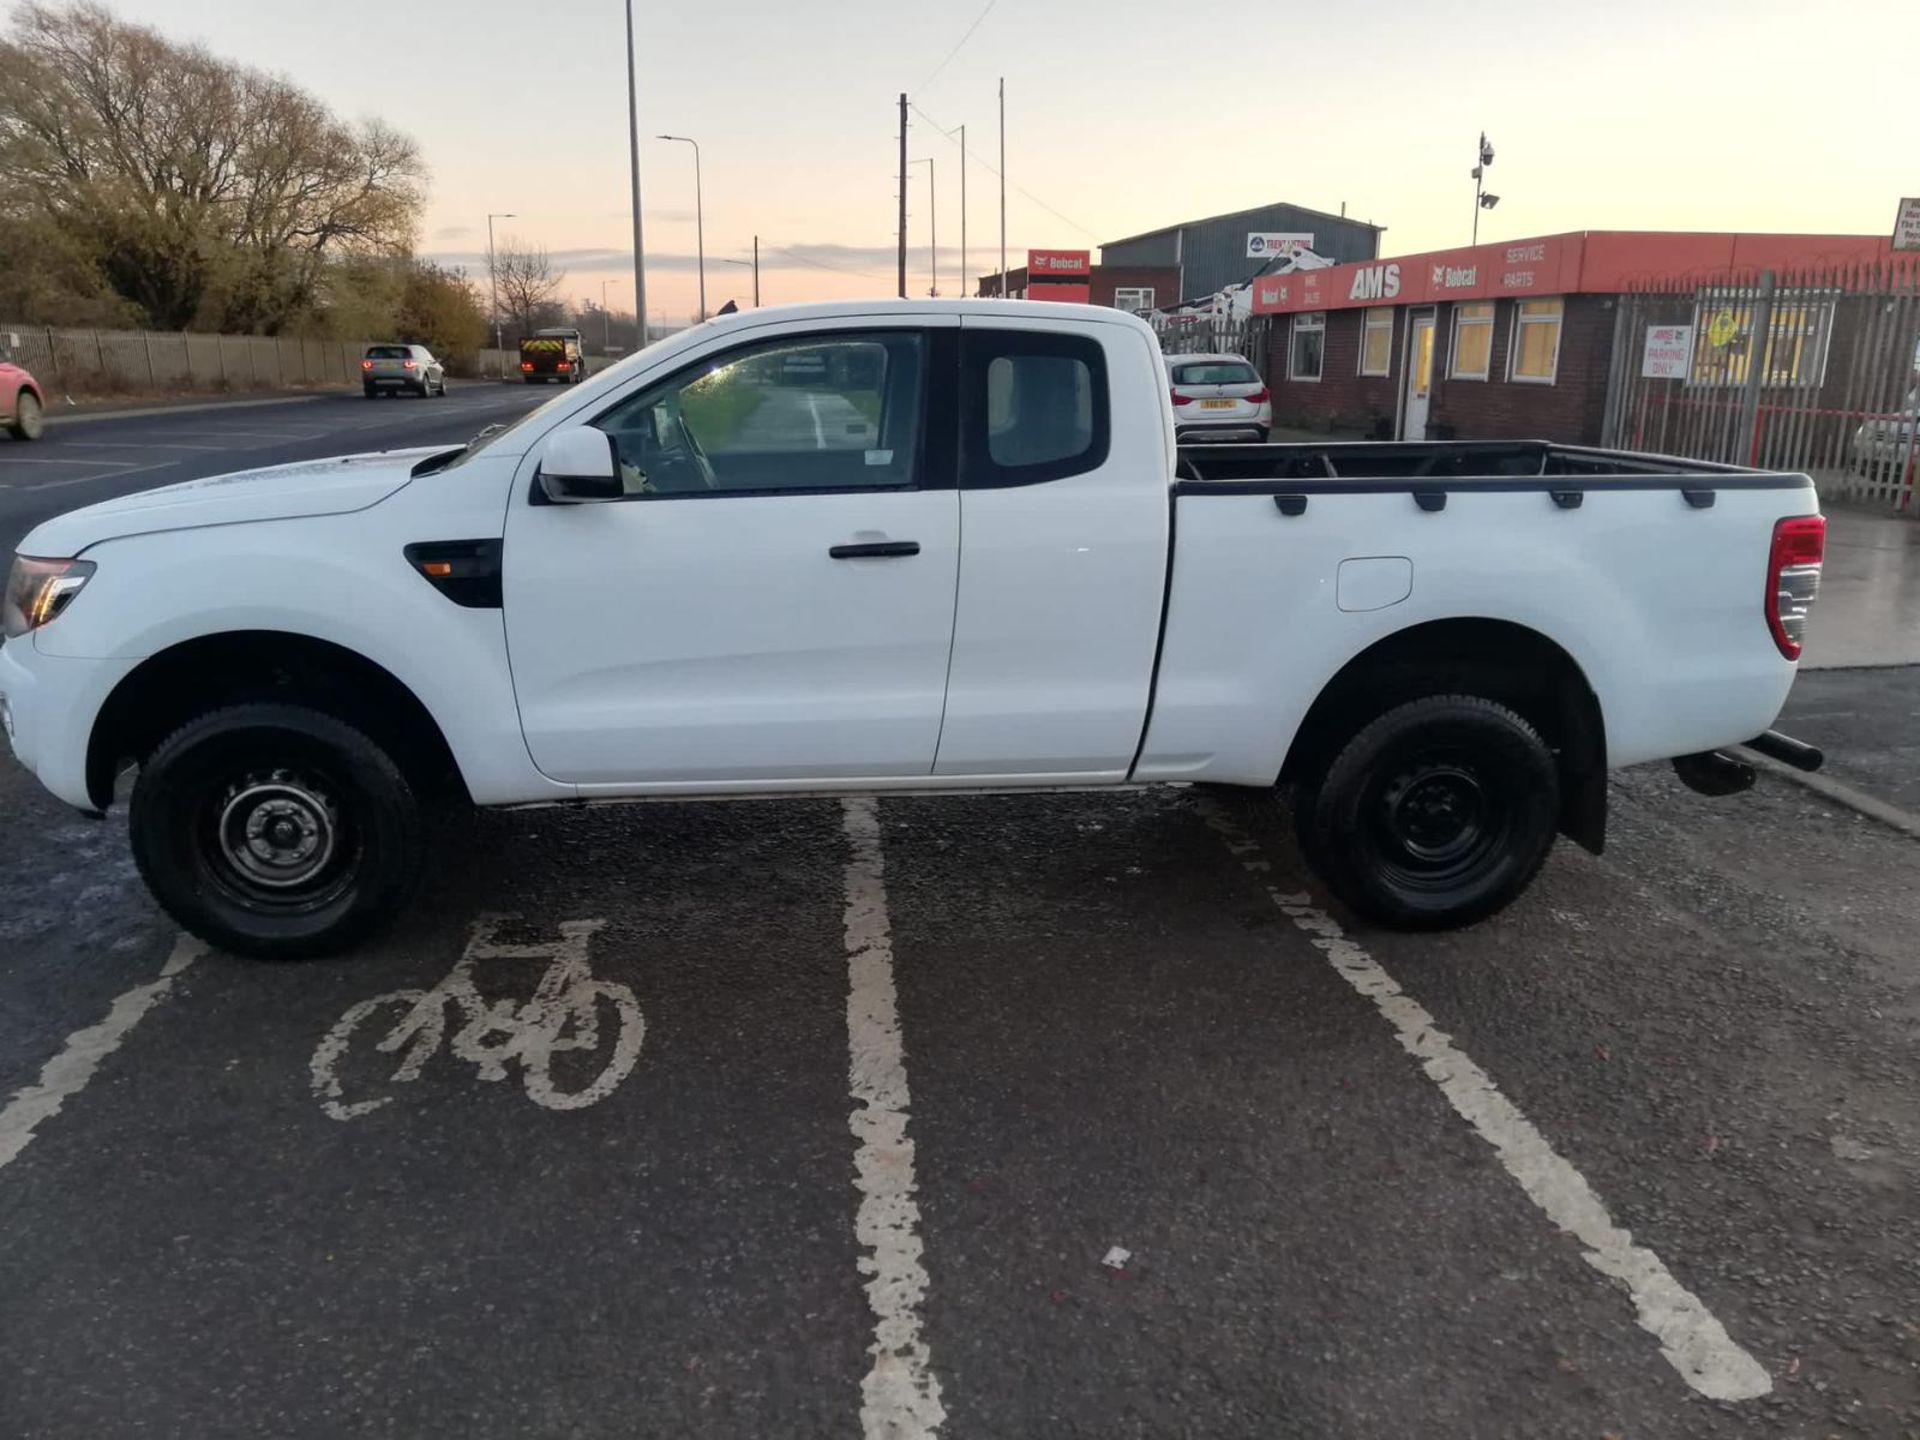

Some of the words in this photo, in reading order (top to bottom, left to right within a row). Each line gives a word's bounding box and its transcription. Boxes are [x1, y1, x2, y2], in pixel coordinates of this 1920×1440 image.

[1267, 240, 1286, 250] TRENT
[1507, 244, 1545, 263] SERVICE
[1050, 256, 1083, 269] Bobcat
[1349, 263, 1401, 300] AMS
[1445, 265, 1477, 288] Bobcat
[1504, 271, 1534, 288] PARTS
[1649, 348, 1684, 360] PARKING
[1653, 362, 1673, 374] ONLY
